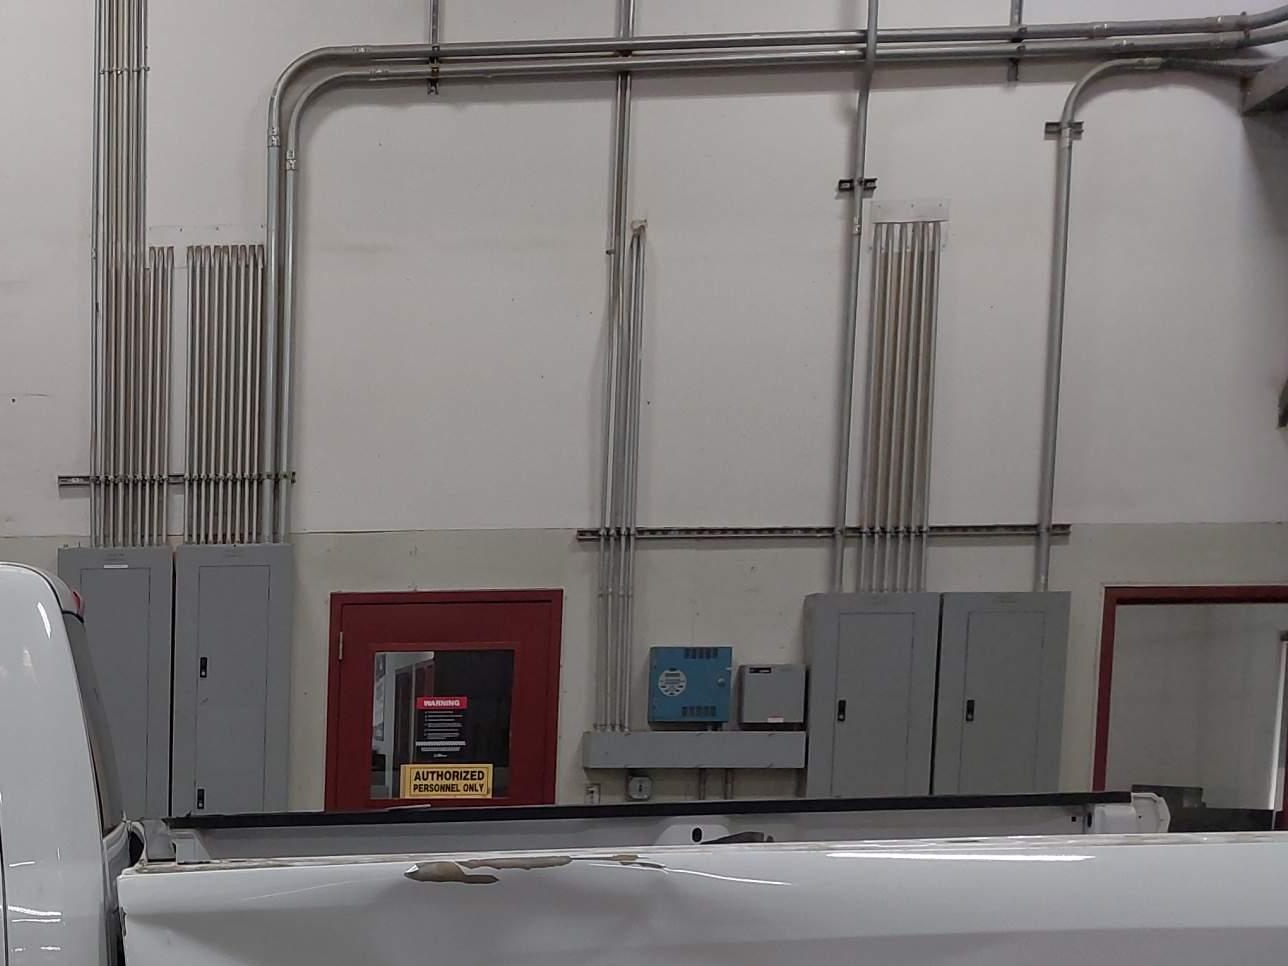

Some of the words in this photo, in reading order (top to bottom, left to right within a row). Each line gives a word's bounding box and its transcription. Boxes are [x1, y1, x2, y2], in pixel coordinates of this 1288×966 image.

[414, 770, 485, 781] AUTHORIZED
[413, 783, 460, 793] PERSONNEL
[463, 783, 484, 792] ONLY
